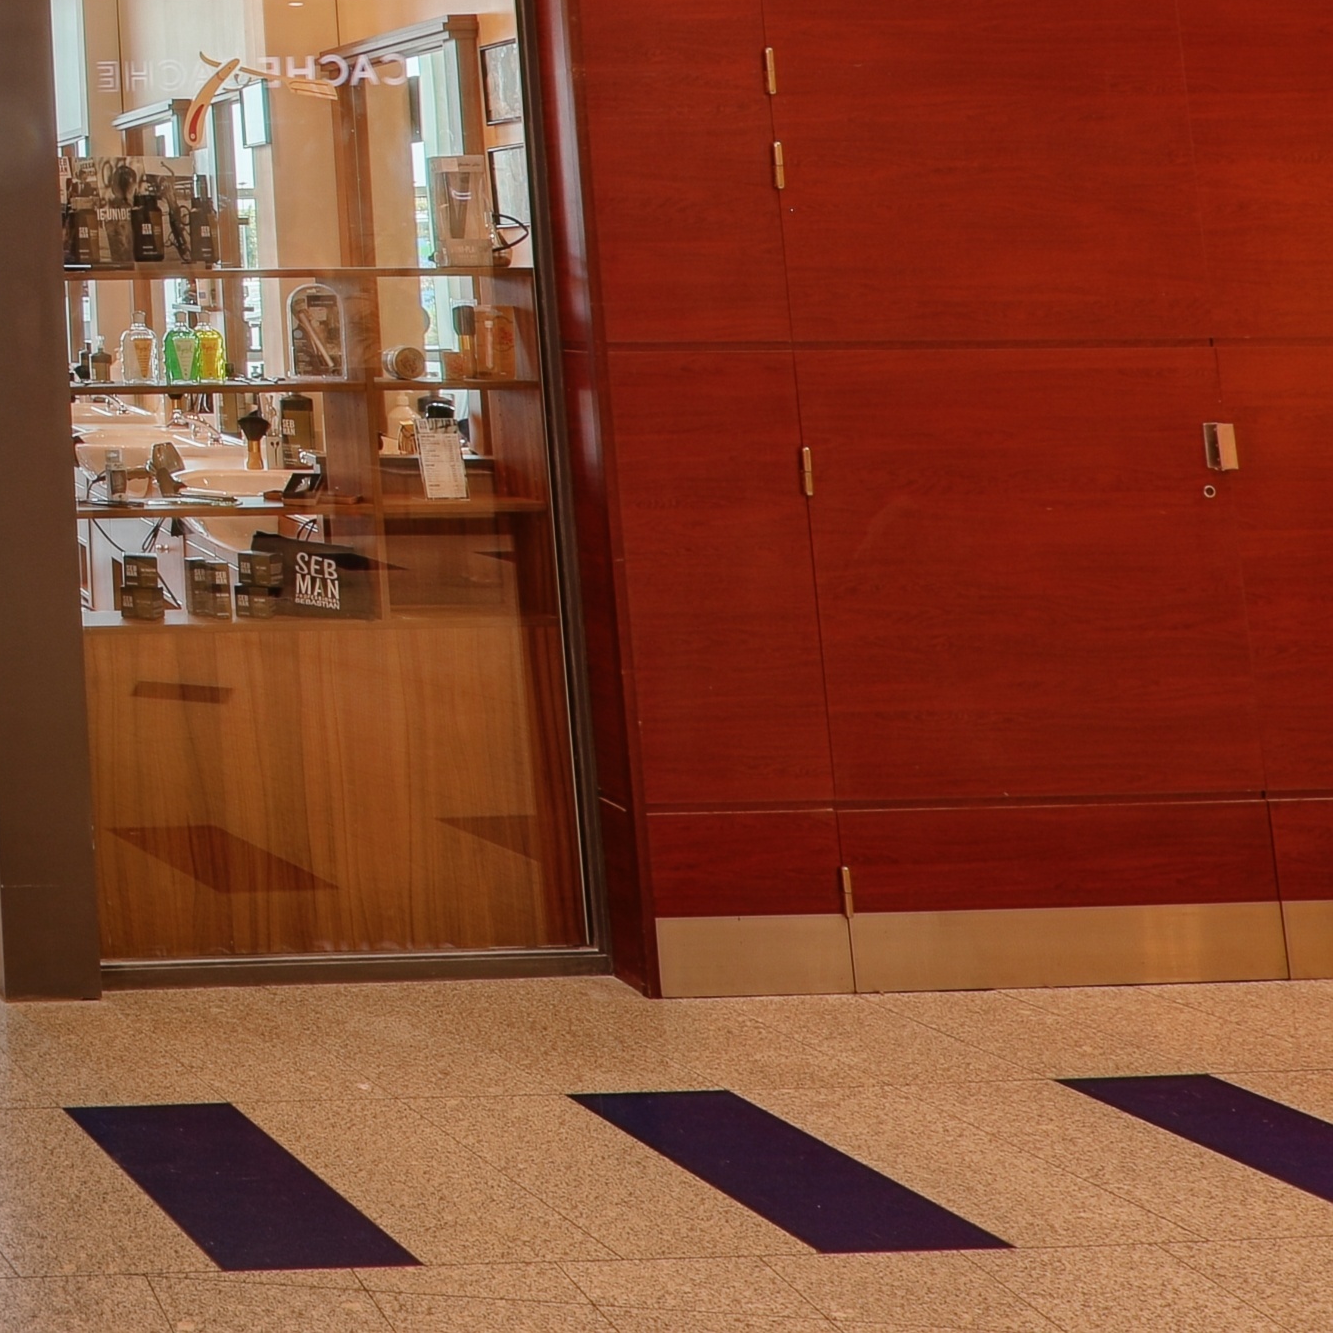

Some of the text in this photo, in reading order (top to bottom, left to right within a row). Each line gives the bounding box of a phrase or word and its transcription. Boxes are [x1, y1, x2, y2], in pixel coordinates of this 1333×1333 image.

[294, 551, 338, 580] SEB
[295, 573, 340, 600] MAN
[294, 597, 341, 610] SEBASTIAN
